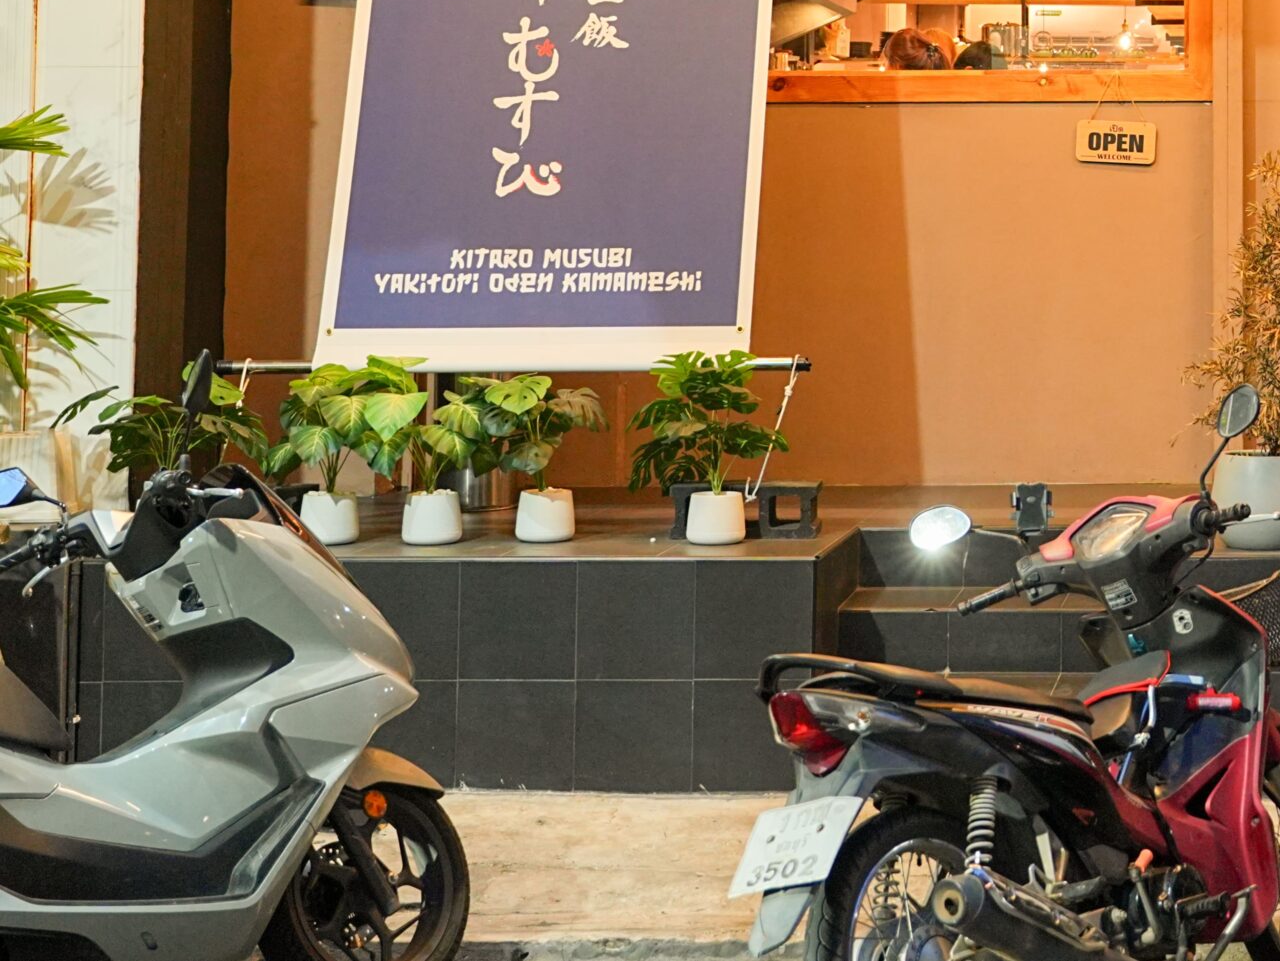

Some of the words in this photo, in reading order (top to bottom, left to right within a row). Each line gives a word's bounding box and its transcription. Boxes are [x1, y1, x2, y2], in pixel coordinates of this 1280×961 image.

[1088, 132, 1144, 153] OPEN
[450, 248, 534, 269] KITARO
[542, 248, 632, 269] MUSUBI
[746, 854, 818, 888] 3502
